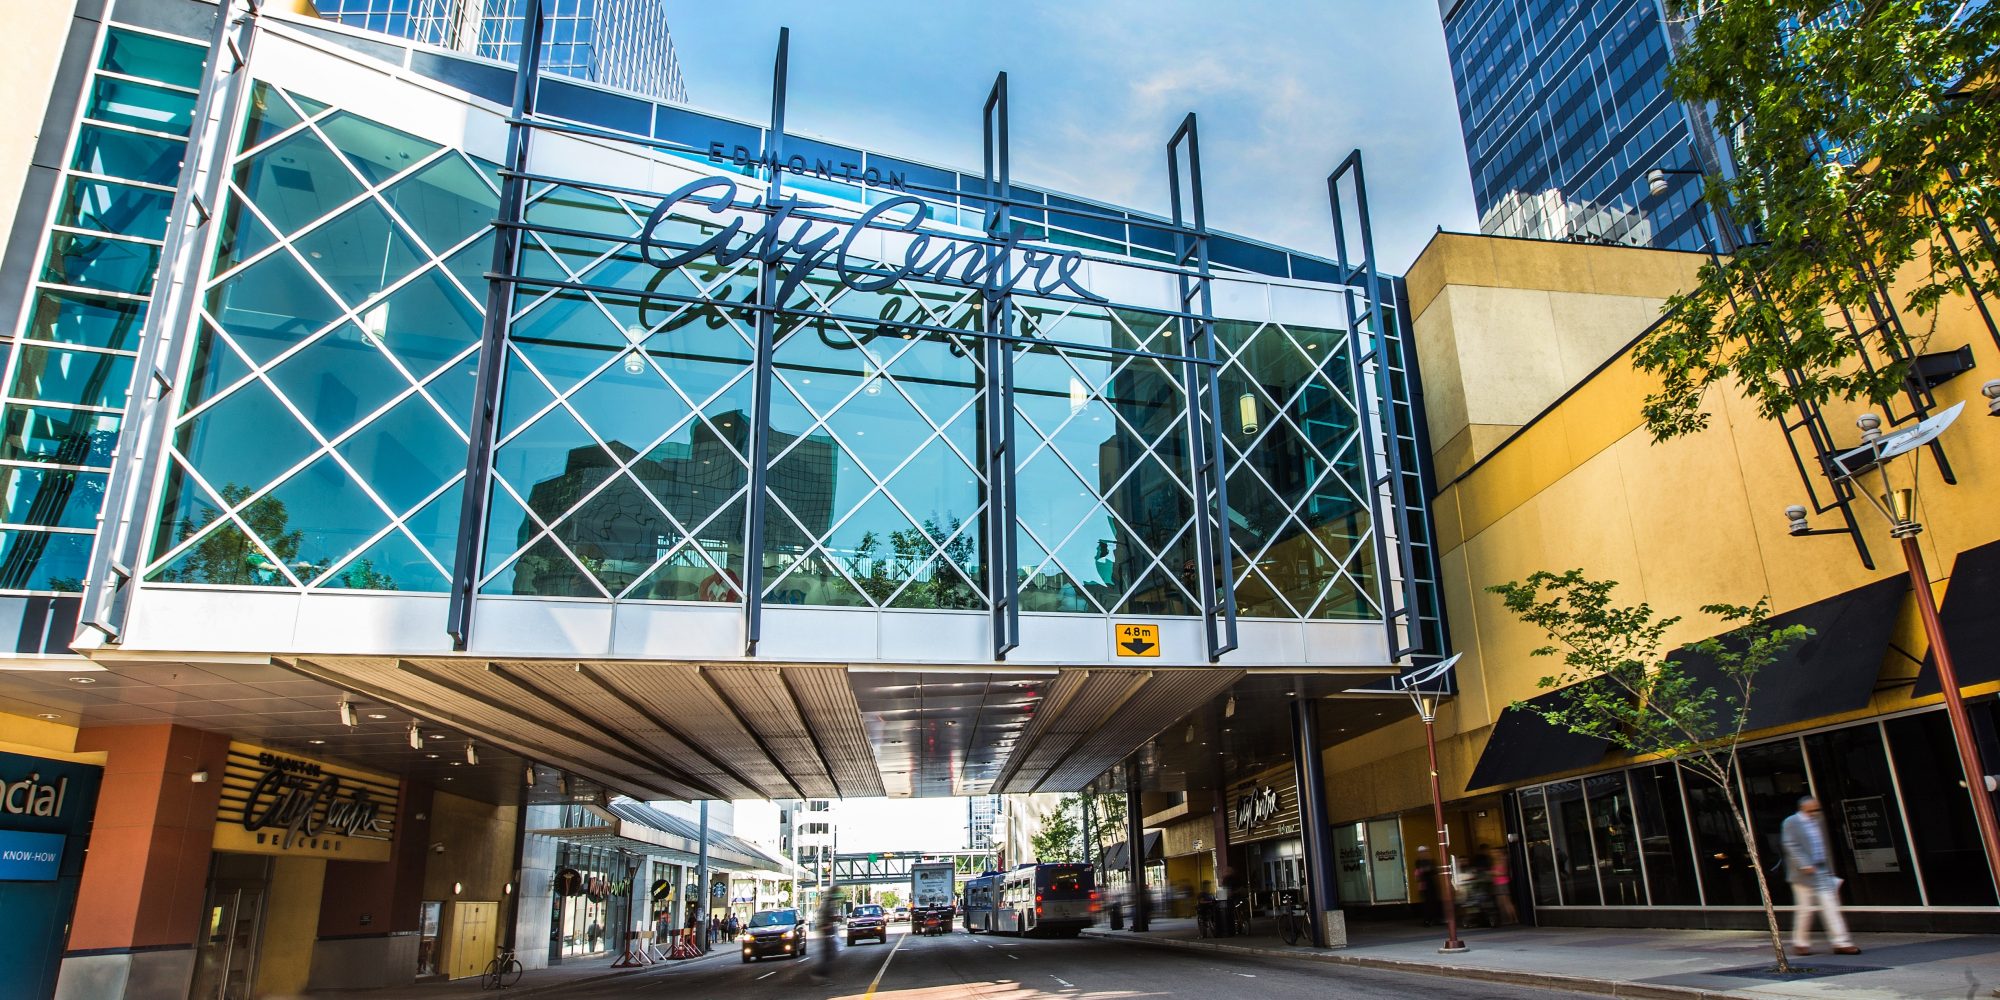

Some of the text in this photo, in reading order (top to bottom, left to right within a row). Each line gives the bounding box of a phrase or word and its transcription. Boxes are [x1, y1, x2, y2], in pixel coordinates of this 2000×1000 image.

[709, 140, 907, 192] EDMONTON
[256, 833, 342, 851] WECOME
[2, 850, 56, 862] KNOW-HOW
